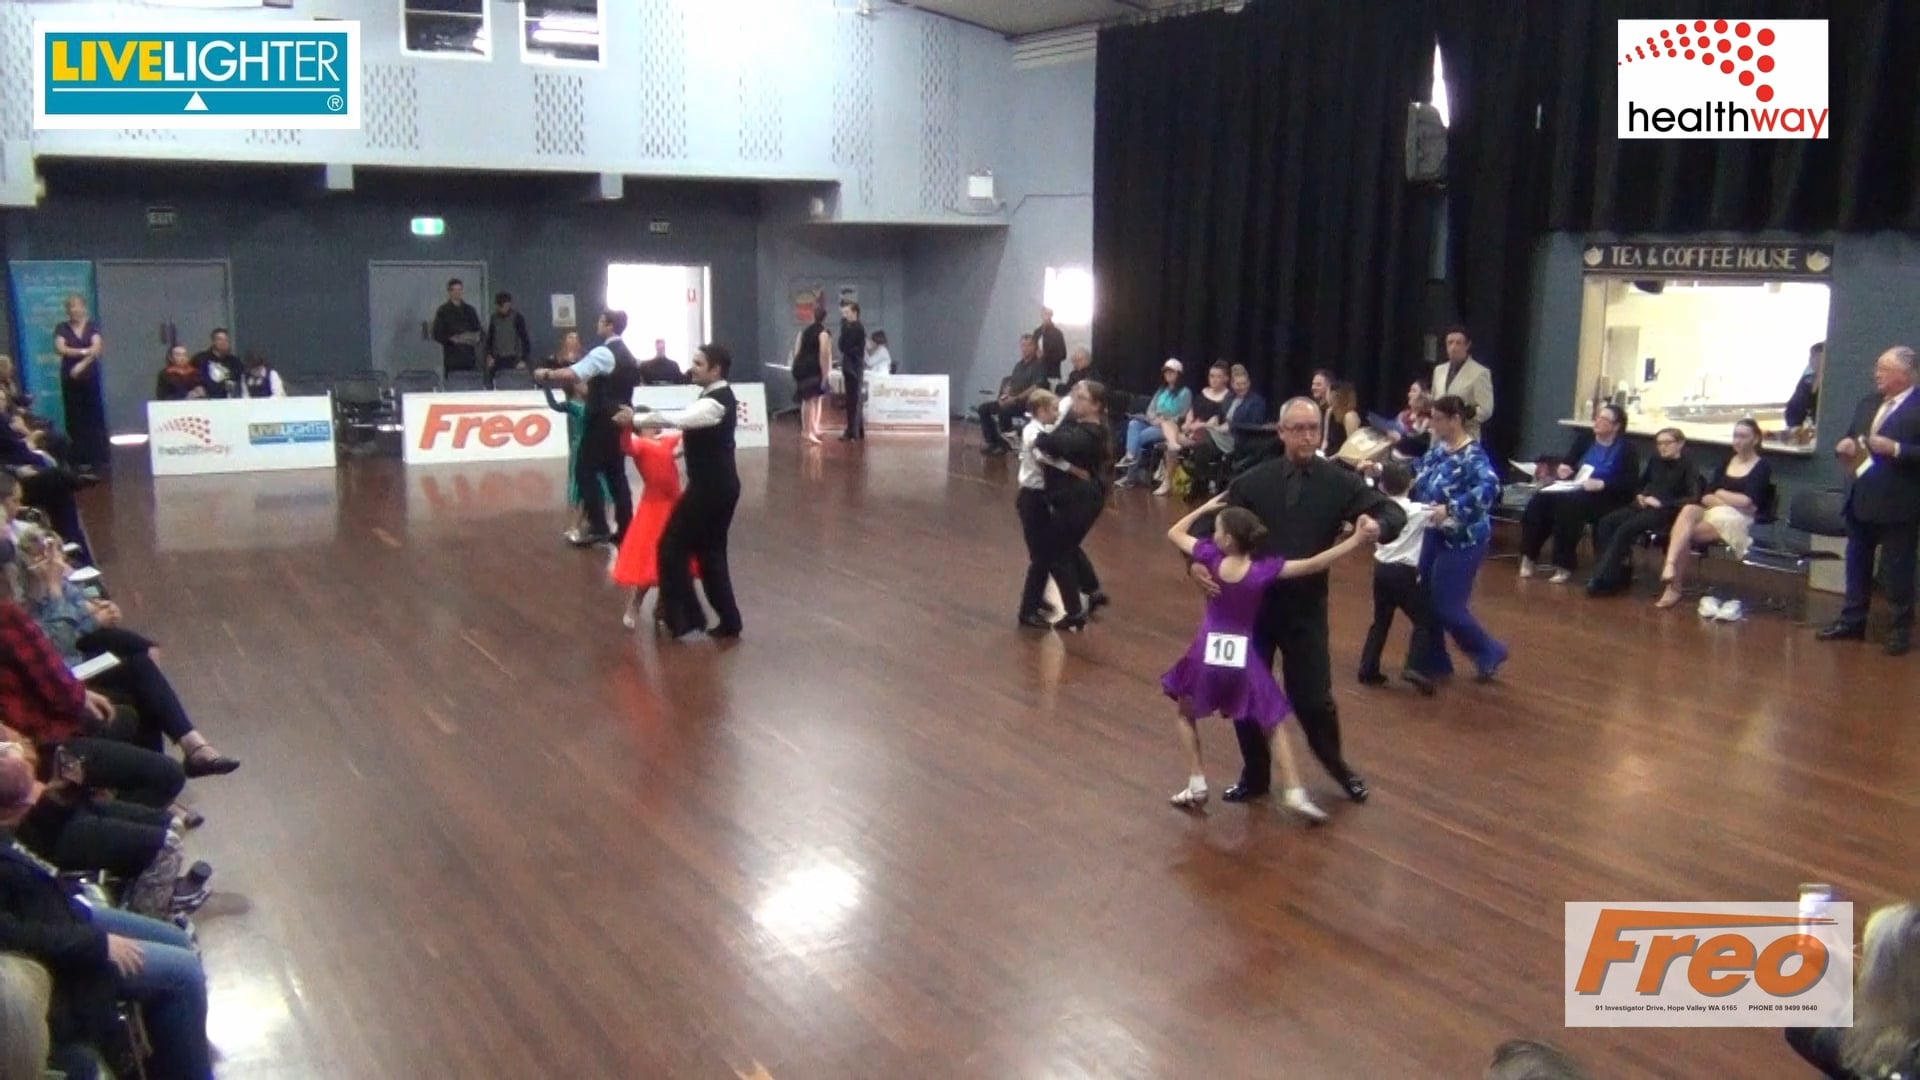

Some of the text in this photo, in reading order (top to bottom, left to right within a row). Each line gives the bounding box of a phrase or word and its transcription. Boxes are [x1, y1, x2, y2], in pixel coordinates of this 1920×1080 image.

[1611, 246, 1642, 265] TEA
[1662, 247, 1734, 268] COFFEE
[1737, 247, 1797, 270] HOUSE
[419, 404, 552, 449] Freo
[1212, 638, 1236, 661] 10
